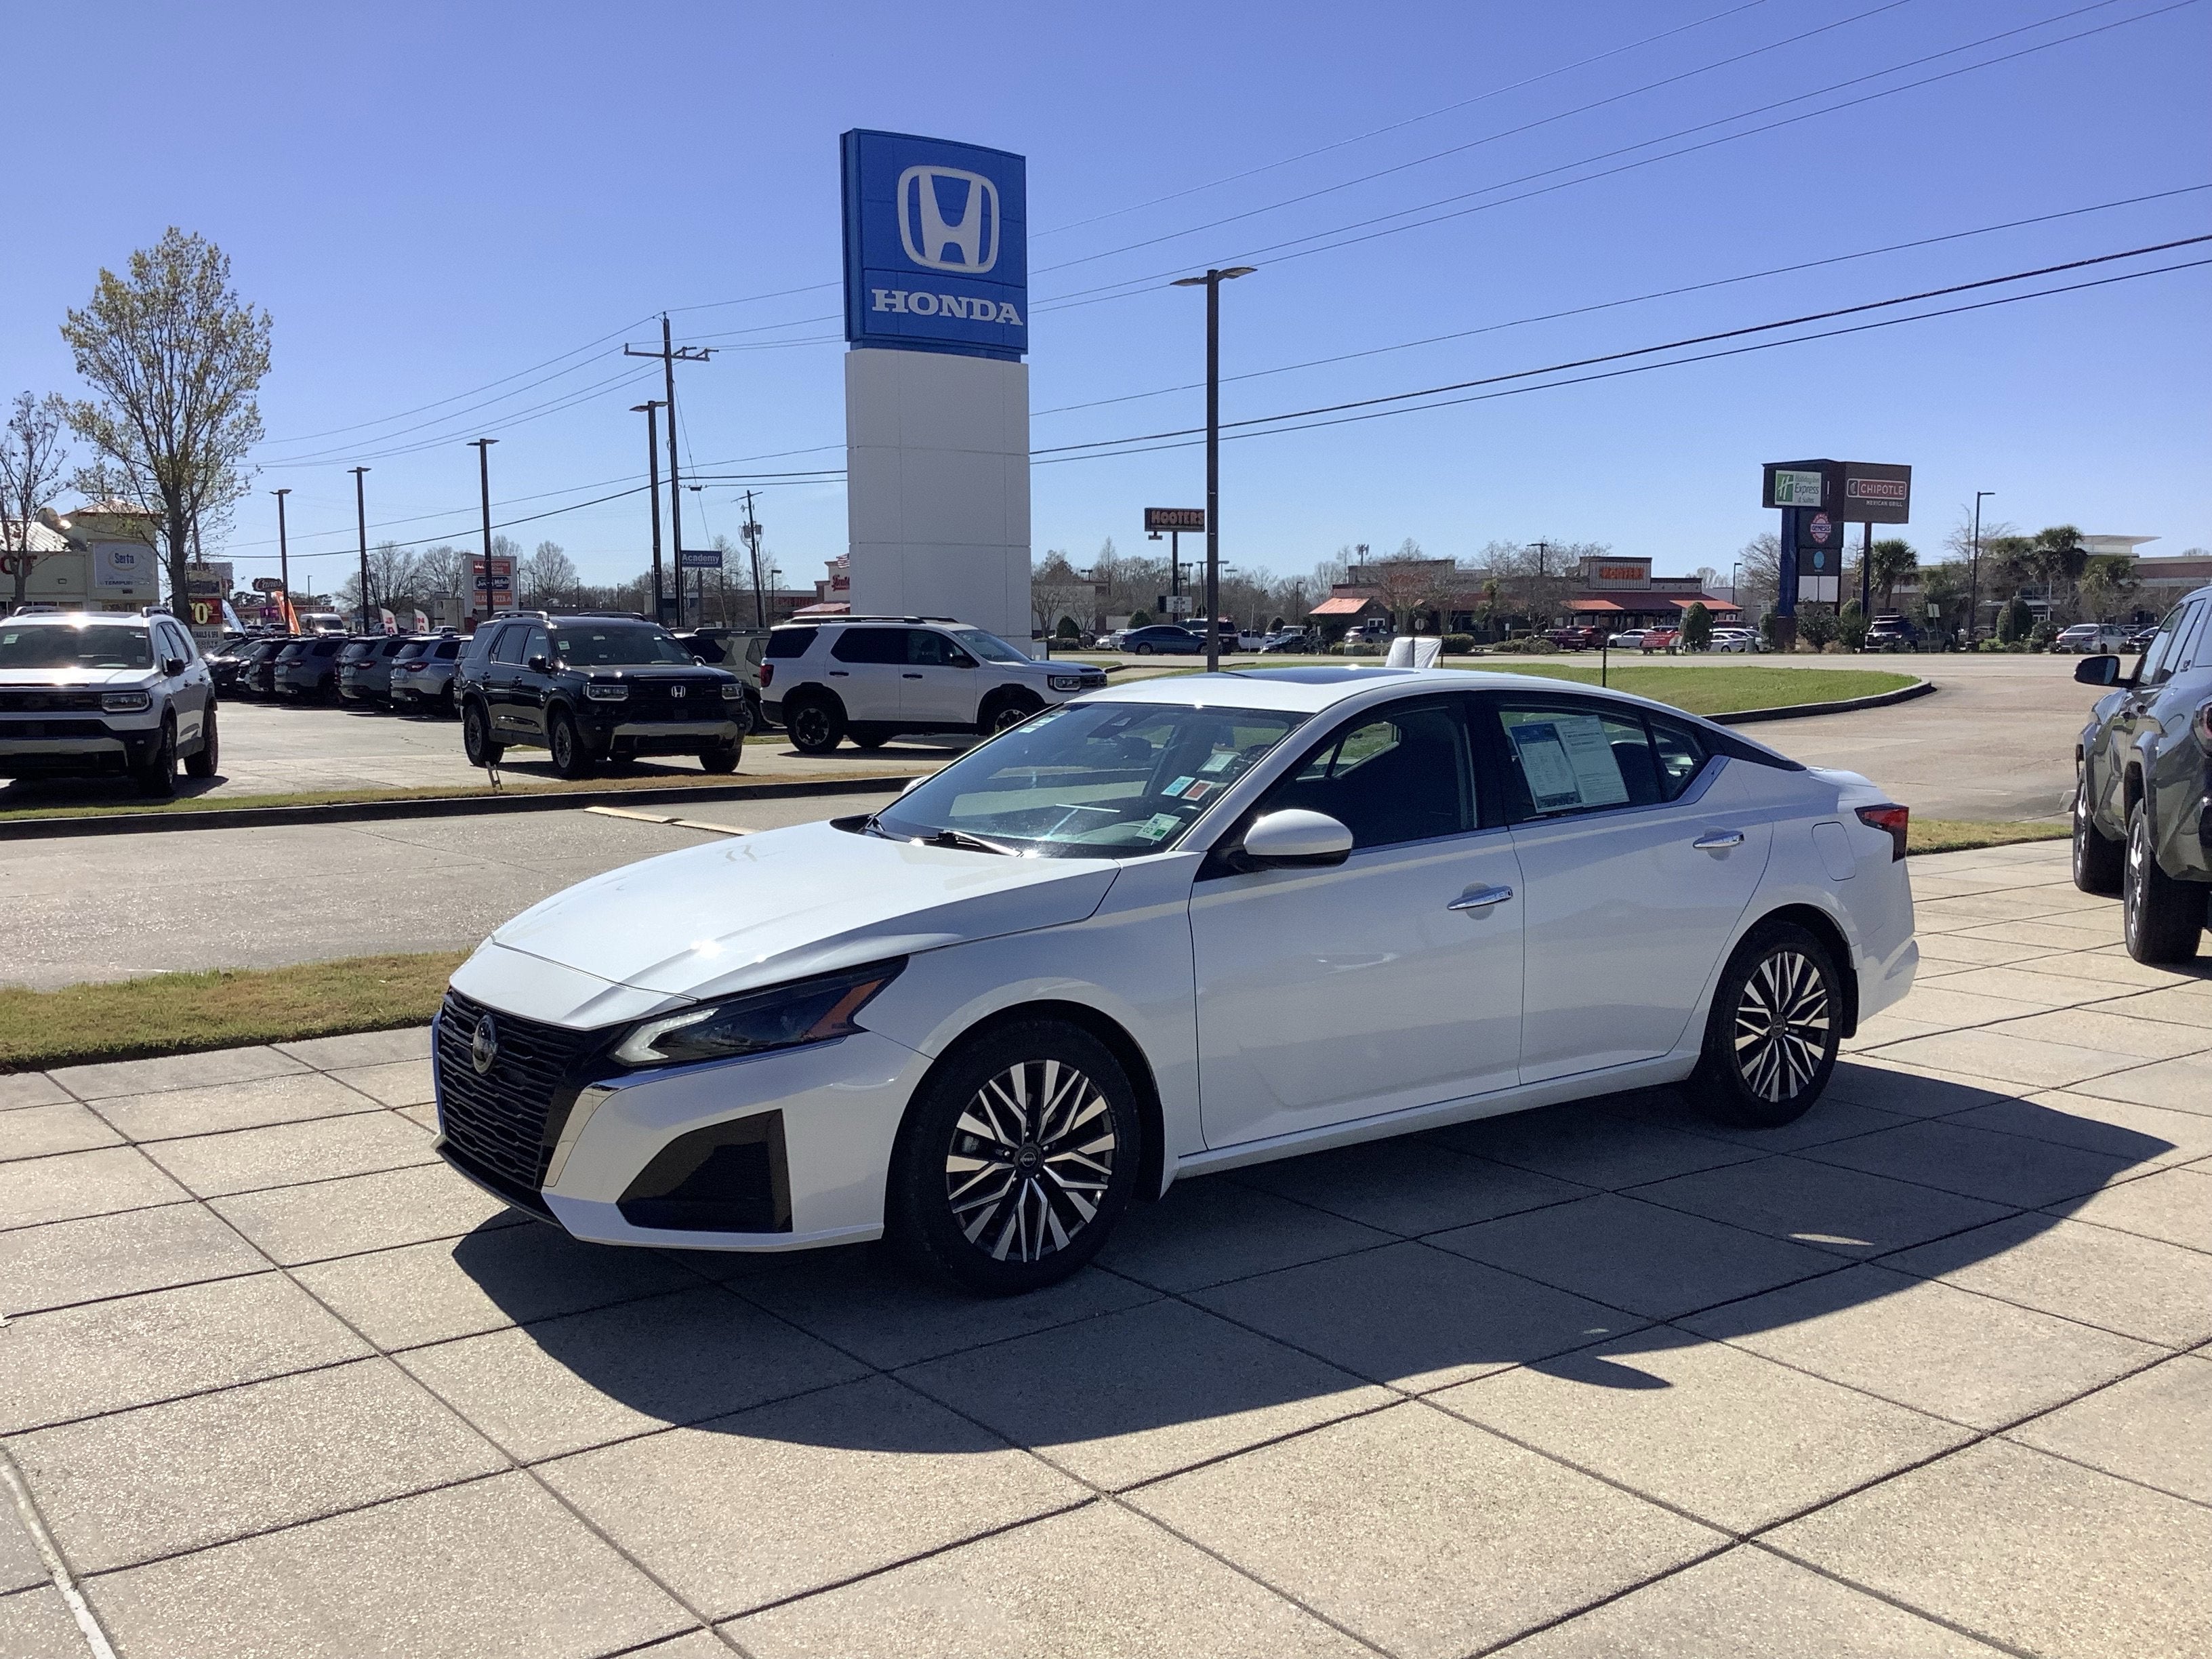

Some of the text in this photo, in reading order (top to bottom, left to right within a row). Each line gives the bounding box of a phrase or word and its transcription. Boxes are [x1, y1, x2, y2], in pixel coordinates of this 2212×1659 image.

[871, 289, 1023, 326] HONDA
[1795, 483, 1819, 495] Express
[1860, 483, 1904, 495] CHIPOTLE
[1151, 510, 1204, 525] HOOTERS
[115, 552, 135, 565] Serta
[682, 553, 720, 564] Academy
